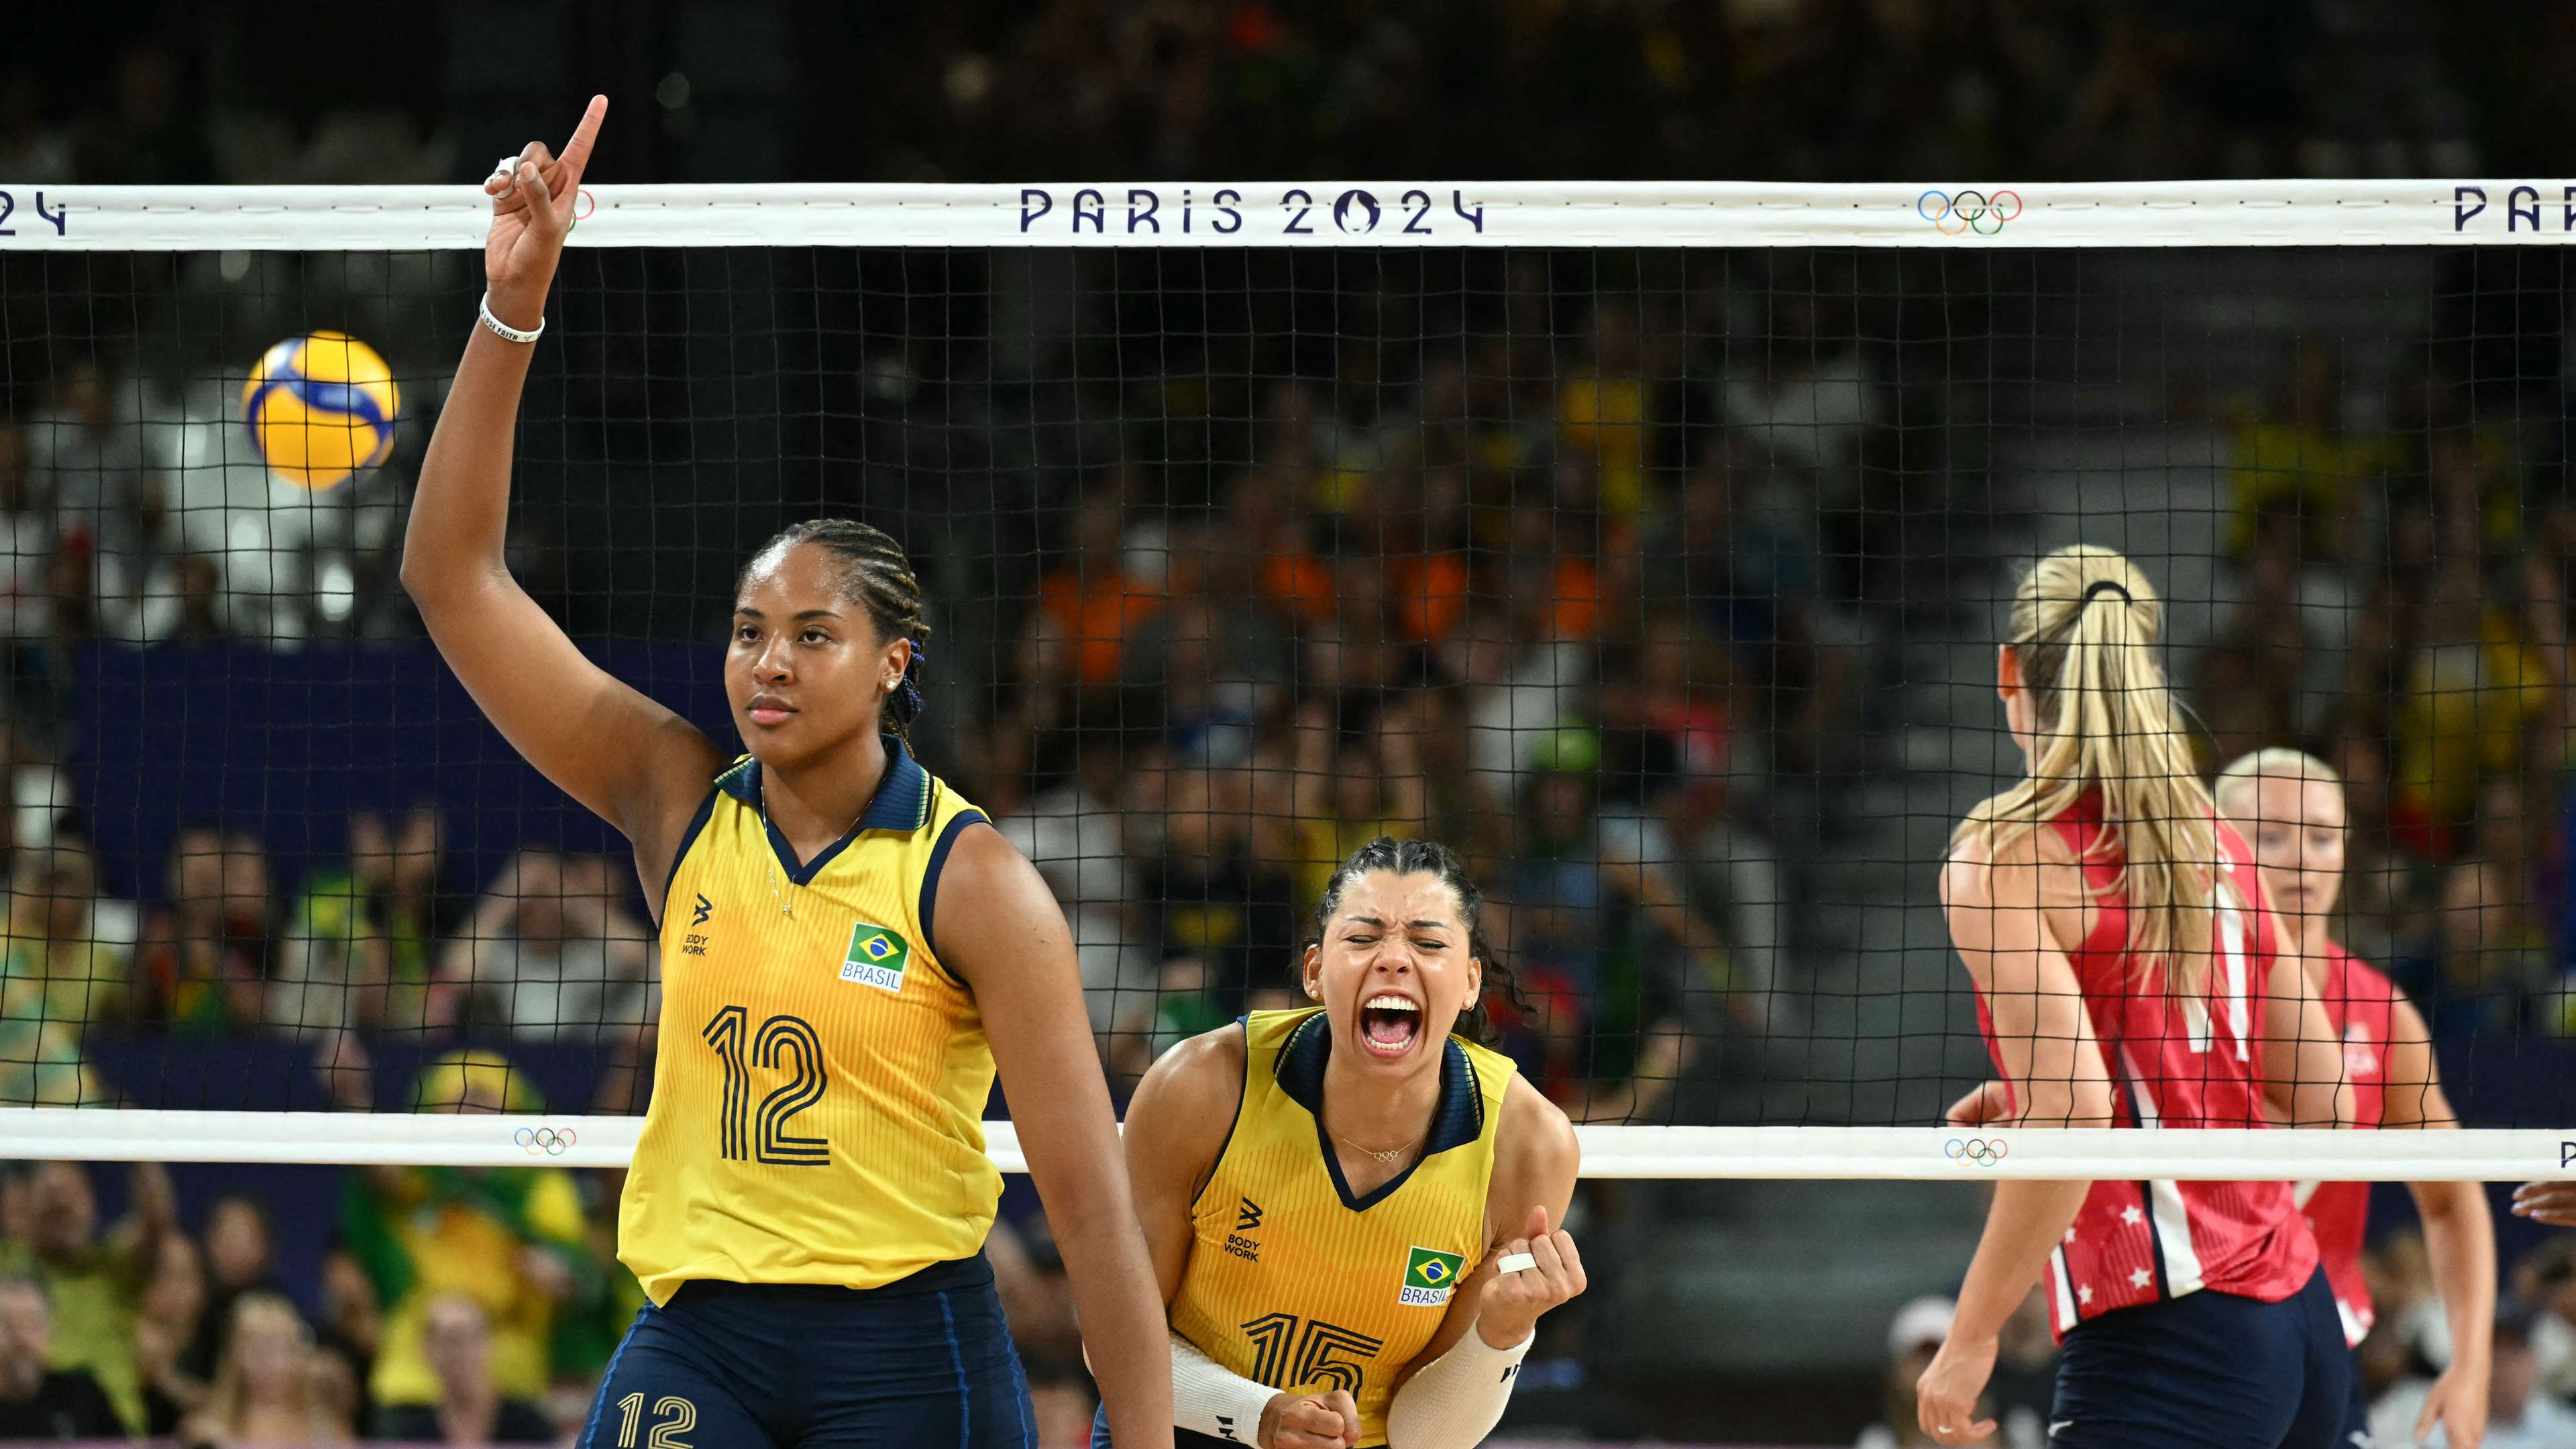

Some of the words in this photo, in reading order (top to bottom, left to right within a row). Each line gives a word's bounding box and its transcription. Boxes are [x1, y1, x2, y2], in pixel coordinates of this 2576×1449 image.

[497, 327, 519, 341] FAITH
[682, 945, 706, 957] WORK
[843, 963, 899, 989] BRASIL
[702, 1005, 830, 1166] 12
[1228, 1234, 1260, 1251] BODY
[1224, 1242, 1259, 1263] WORK
[1401, 1287, 1447, 1303] BRASIL
[617, 1392, 696, 1449] 12
